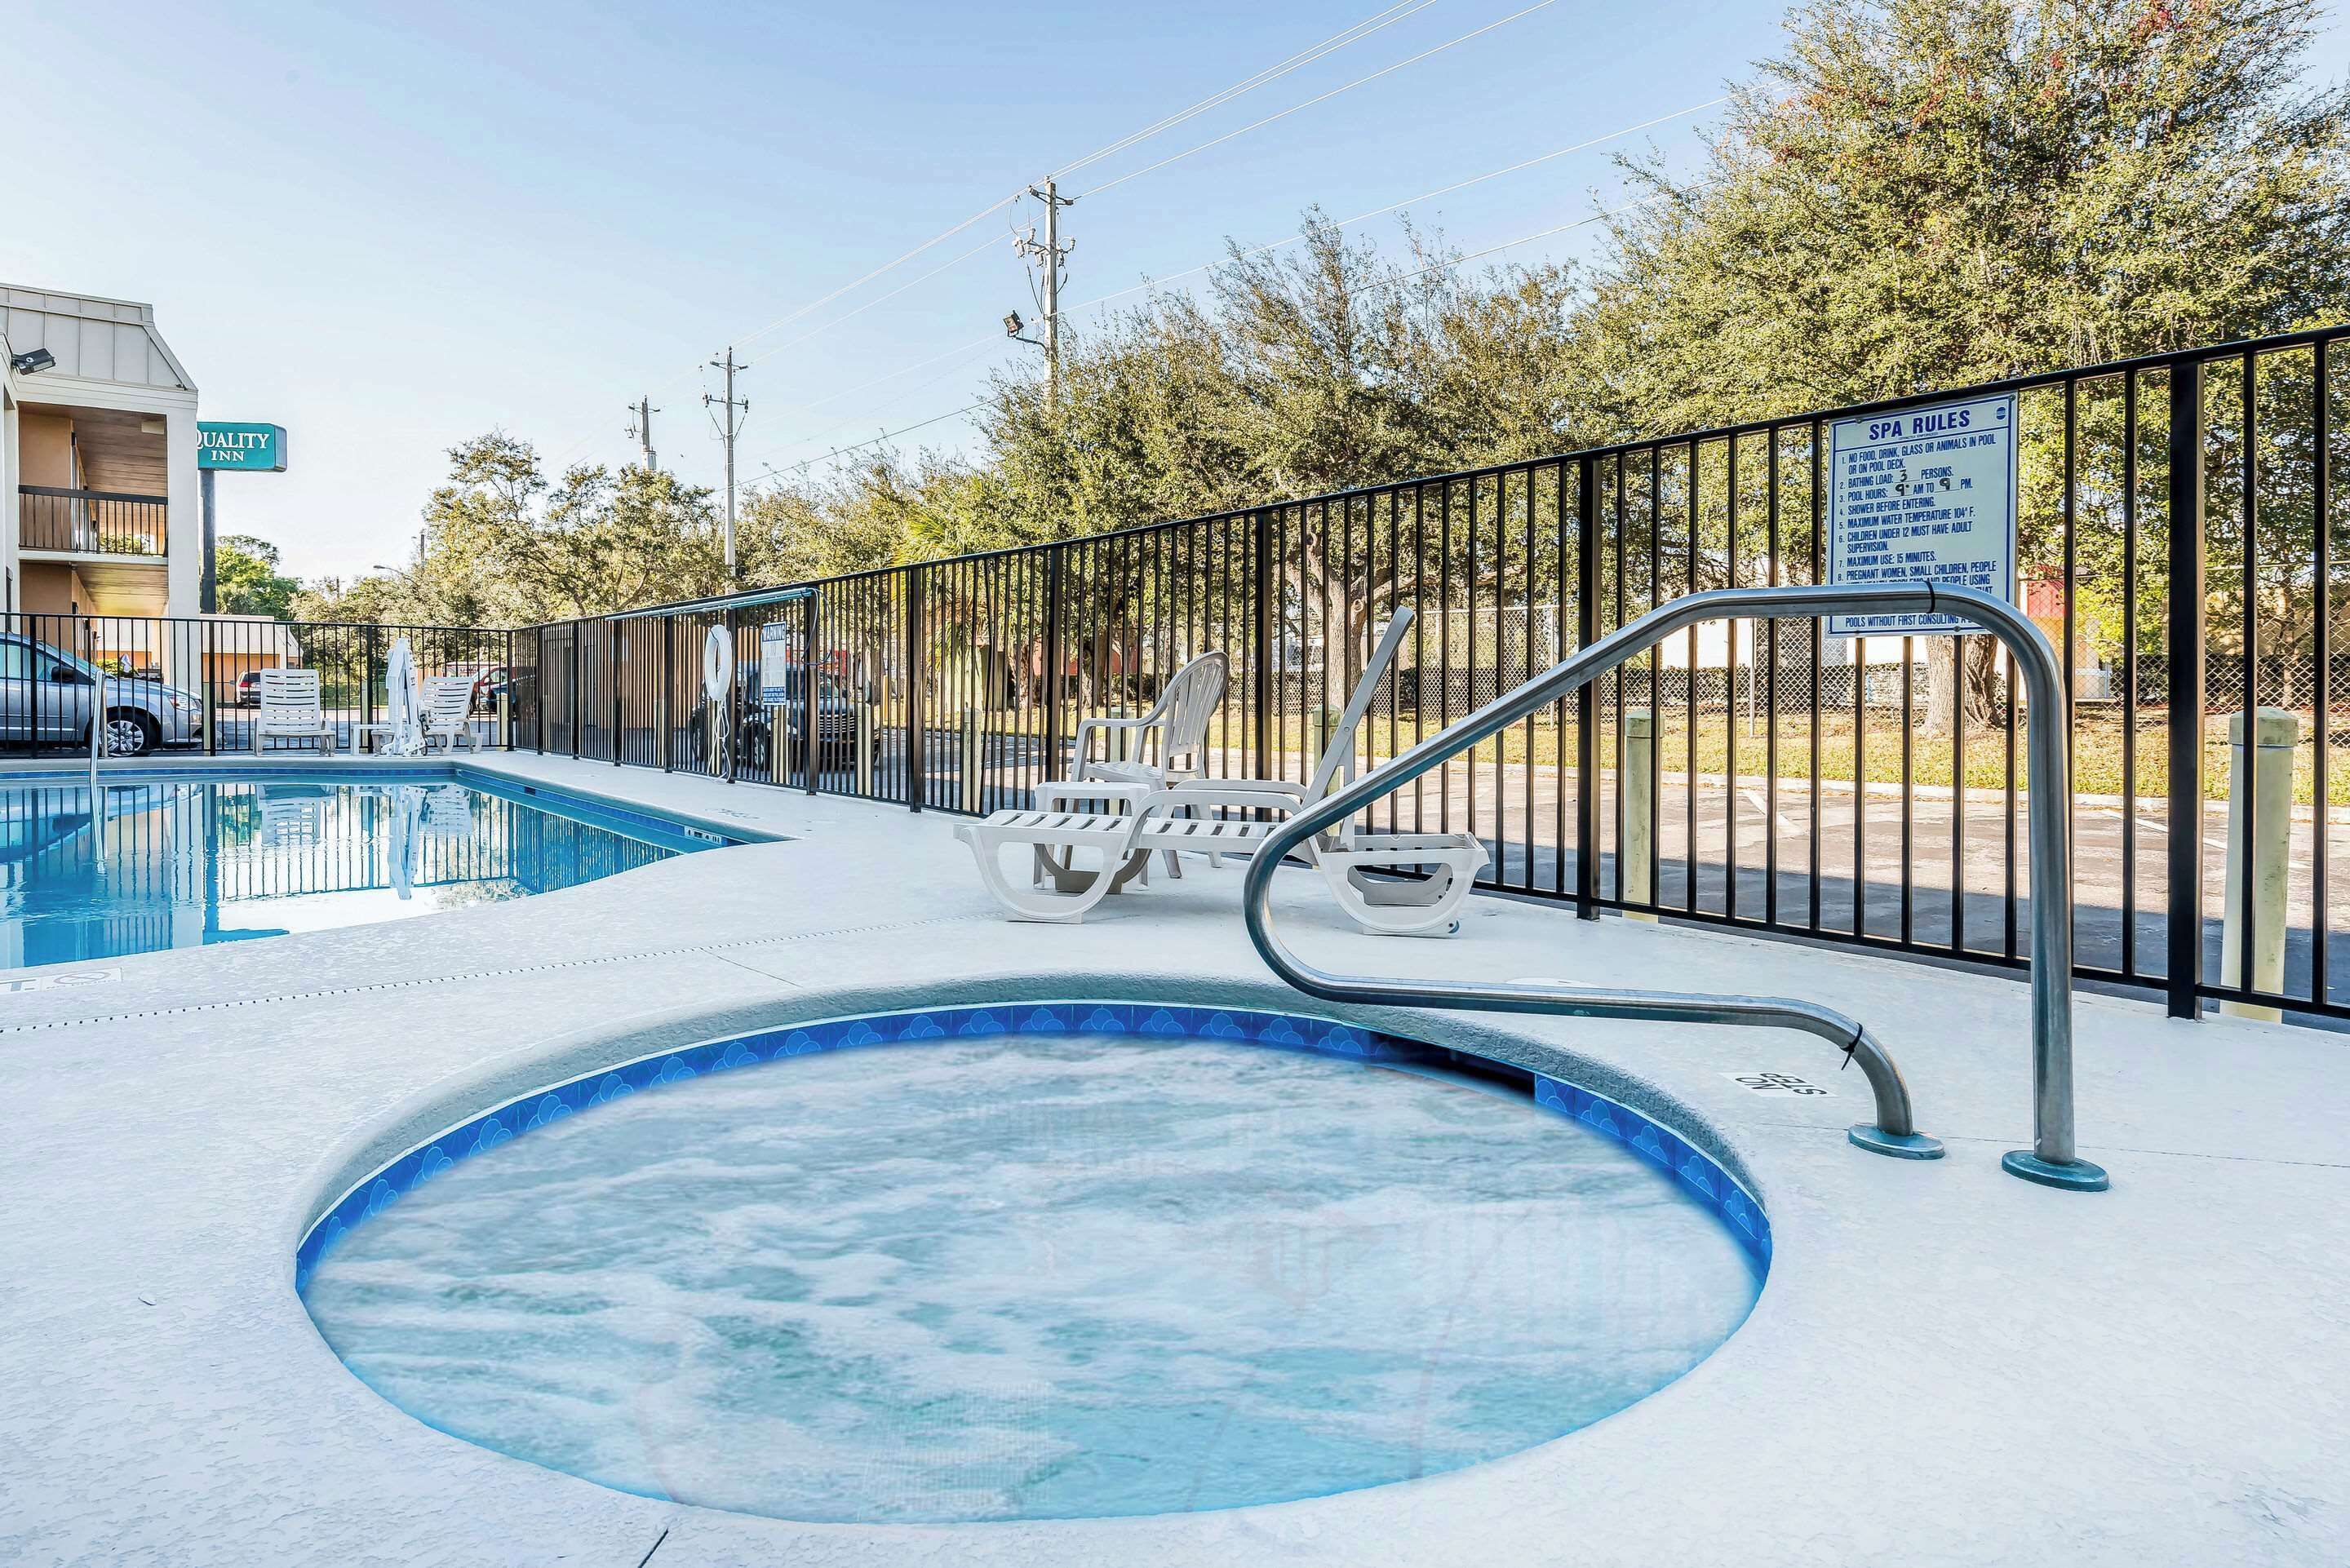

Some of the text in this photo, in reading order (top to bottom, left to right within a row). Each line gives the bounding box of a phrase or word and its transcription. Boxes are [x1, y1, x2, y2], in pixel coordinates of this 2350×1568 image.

[1869, 420, 1903, 440] SPA
[1913, 410, 1970, 434] RULES
[211, 450, 244, 462] INN
[1848, 453, 1857, 463] NO
[1859, 450, 1877, 462] FOOD,
[1878, 447, 1900, 459] DRINK,
[1901, 443, 1923, 456] GLASS
[1925, 441, 1934, 454] OR
[1936, 437, 1966, 451] ANIMALS
[1969, 436, 1976, 448] IN
[1978, 433, 1997, 446] POOL
[1848, 458, 1906, 475] OR ON POOL DECK.
[1839, 466, 1953, 489] 2. BATHING LOAD: 3 PERSONS.
[1839, 494, 1845, 503] 3.
[1847, 490, 1864, 502] POOL
[1865, 488, 1888, 500] HOURS:
[1913, 483, 1924, 495] AM
[1926, 482, 1935, 494] TO
[1939, 477, 1950, 490] 9
[1960, 478, 1973, 489] PM.
[1847, 503, 1874, 515] SHOWER
[1876, 500, 1900, 512] BEFORE
[1902, 496, 1935, 510] ENTERING.
[1838, 521, 1845, 529] 5.
[1847, 516, 1879, 529] MAXIMUM
[1881, 513, 1902, 525] WATER
[1904, 509, 1952, 523] TEMPERATURE
[1969, 506, 1975, 517] F.
[1838, 520, 1973, 543] 6. CHILDREN UNDER 12 MUST HAVE ADULT
[1847, 541, 1889, 554] SUPERVISION.
[1838, 550, 1937, 568] 7. MAXIMUM USE: 15 MINUTES.
[1838, 573, 1843, 582] 8.
[1846, 569, 1879, 581] PREGNANT
[1881, 567, 1907, 578] WOMEN,
[1909, 565, 1932, 577] SMALL
[1934, 562, 1969, 576] CHILDREN,
[1971, 560, 1997, 573] PEOPLE
[1942, 574, 1967, 586] PEOPLE
[1969, 574, 1990, 586] USING
[1846, 617, 1865, 627] POOLS
[1867, 615, 1896, 627] WITHOUT
[1898, 614, 1918, 626] FIRST
[1918, 613, 1959, 625] CONSULTING
[763, 624, 785, 640] WARNING
[1735, 1076, 1786, 1090] NO
[1759, 1073, 1828, 1095] STEP
